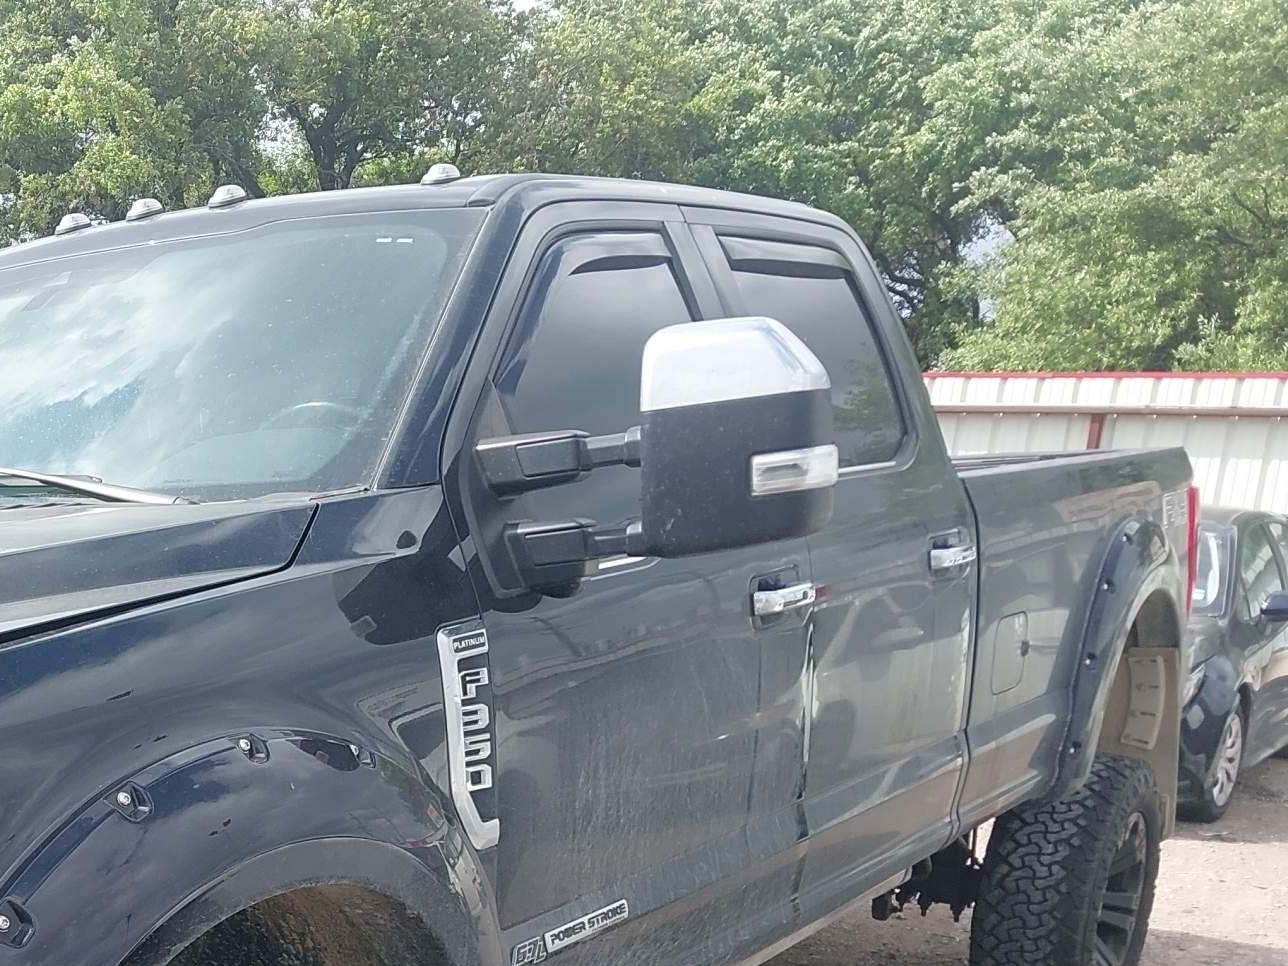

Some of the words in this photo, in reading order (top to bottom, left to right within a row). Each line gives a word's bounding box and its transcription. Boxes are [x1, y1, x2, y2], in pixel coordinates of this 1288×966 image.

[453, 636, 485, 650] PLATINUM
[549, 920, 586, 946] POWER
[587, 902, 627, 929] STROKE
